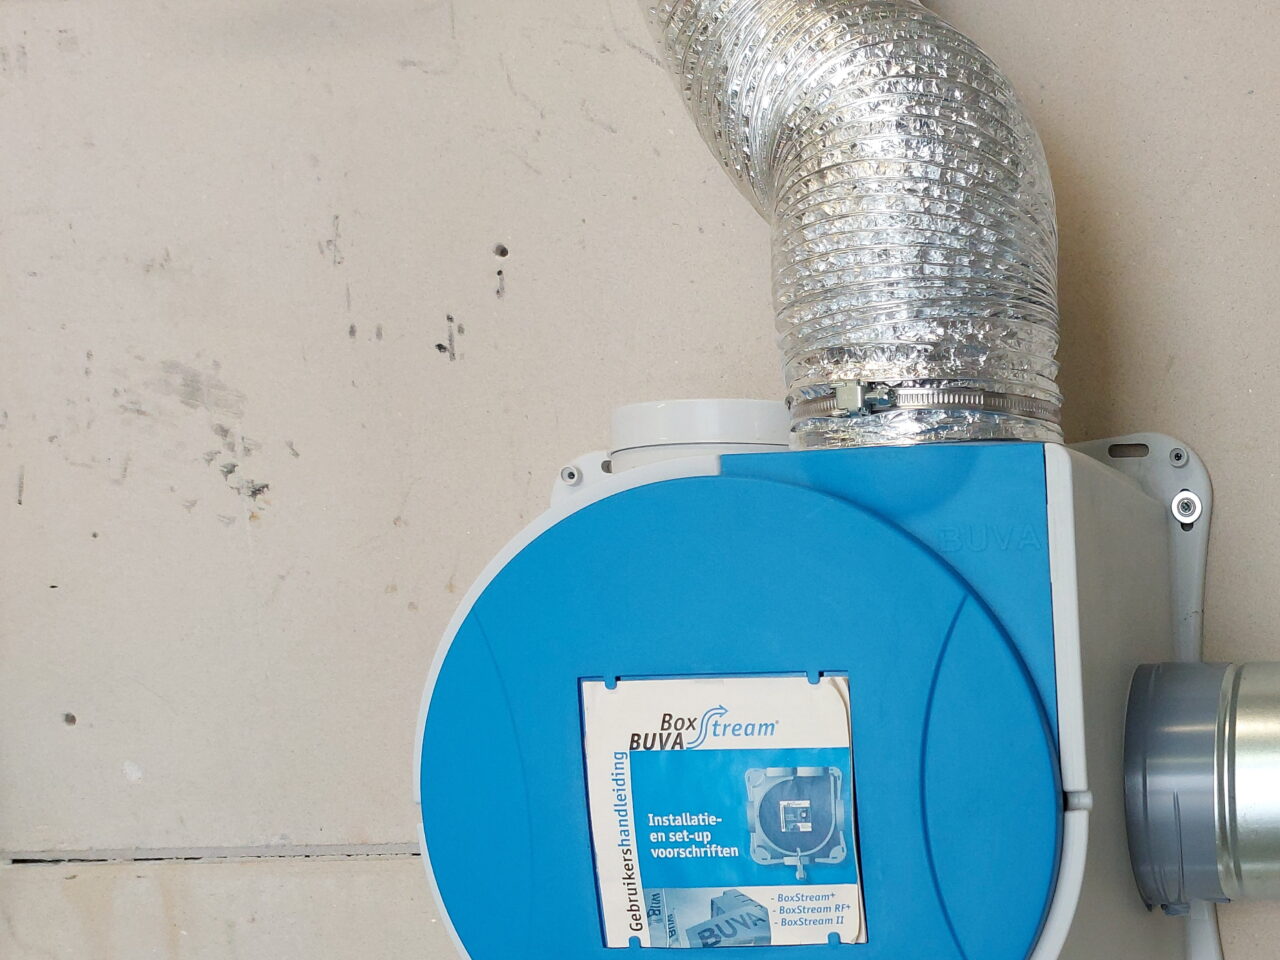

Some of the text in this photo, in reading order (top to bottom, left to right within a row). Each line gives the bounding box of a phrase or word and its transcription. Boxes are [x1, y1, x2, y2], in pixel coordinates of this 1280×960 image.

[938, 523, 1041, 553] BUVA
[629, 732, 685, 750] BUVA
[648, 813, 723, 826] Installatie-
[611, 751, 643, 932] Gebruikershandleiding
[650, 828, 712, 845] en set-up
[651, 844, 739, 858] voorschriften
[778, 892, 836, 903] BoxStream+
[779, 905, 832, 915] BoxStream
[780, 916, 844, 927] BoxStream II
